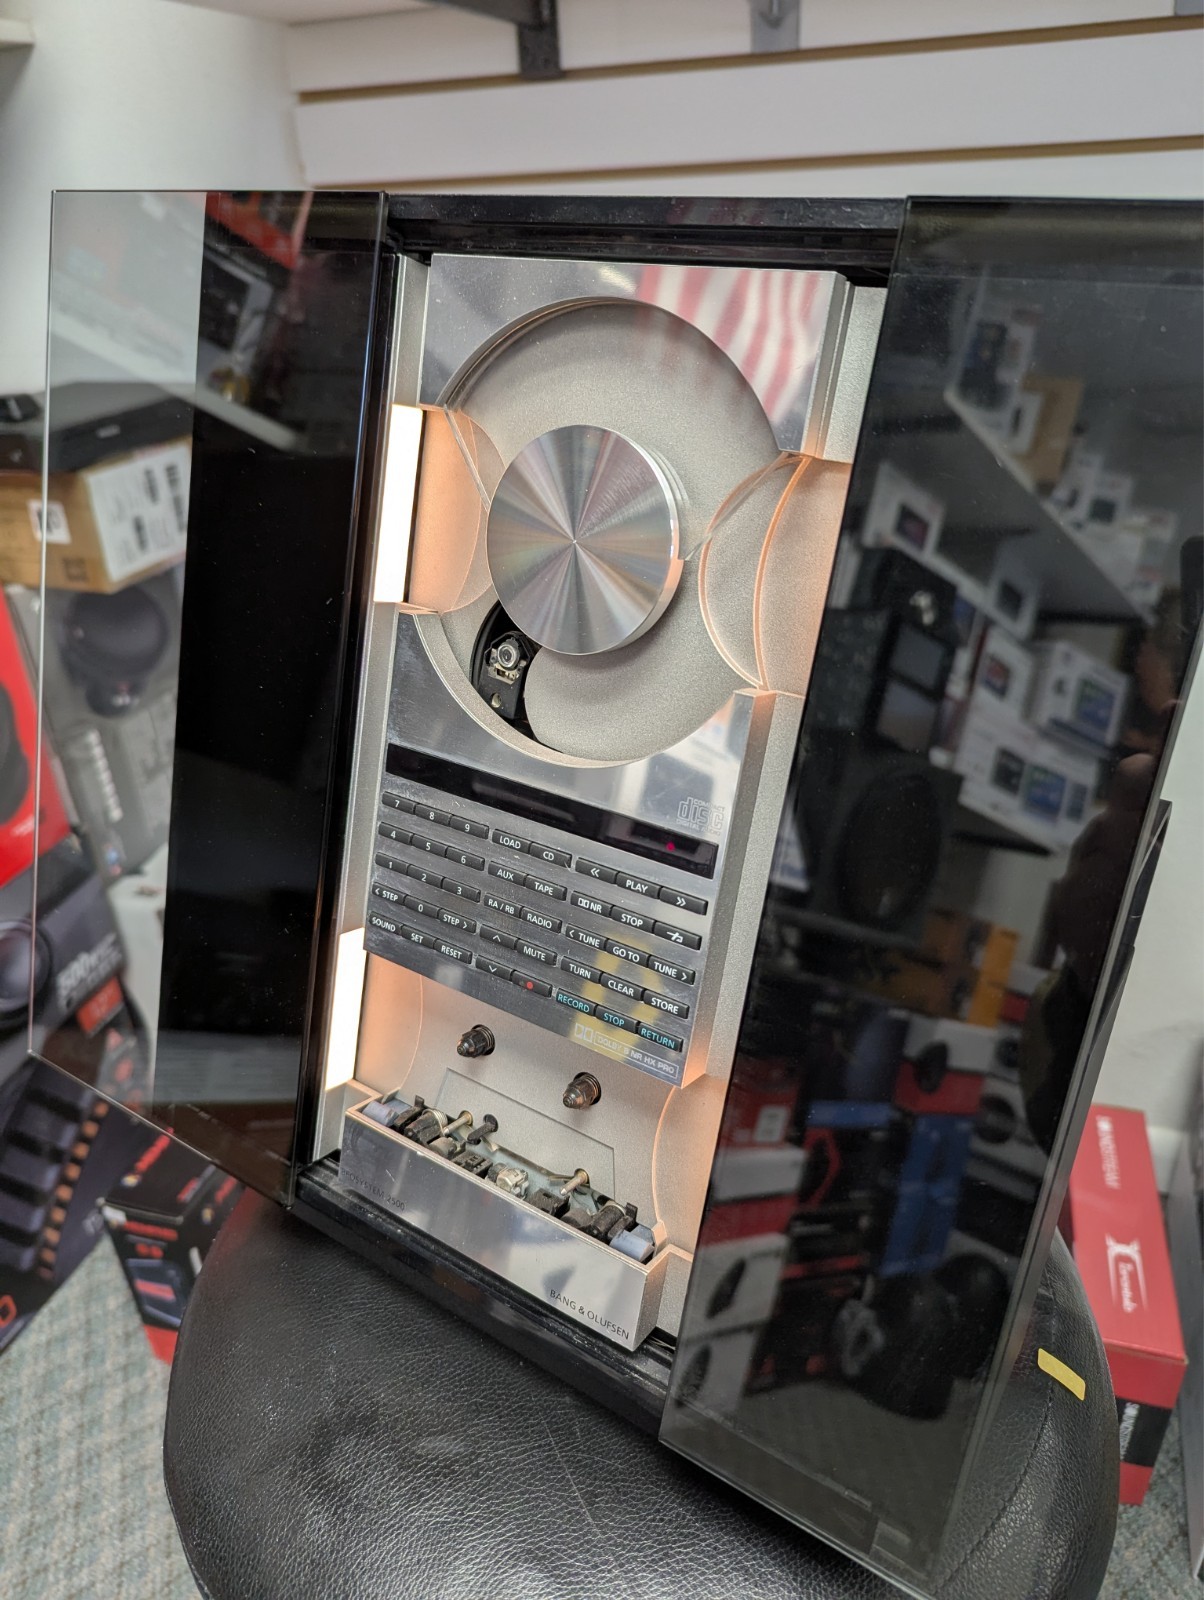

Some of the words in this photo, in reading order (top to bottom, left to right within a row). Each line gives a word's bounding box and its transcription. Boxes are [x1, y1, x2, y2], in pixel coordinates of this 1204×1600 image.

[394, 800, 400, 808] 7
[429, 812, 435, 820] 8
[390, 830, 396, 839] 4
[464, 824, 470, 832] 9
[426, 842, 431, 851] 5
[500, 836, 521, 850] LOAD
[460, 855, 466, 864] 6
[542, 850, 555, 861] CD
[388, 861, 392, 869] 1
[422, 873, 427, 882] 2
[496, 868, 514, 881] AUX
[456, 886, 462, 896] 3
[534, 881, 554, 896] TAPE
[626, 879, 648, 894] PLAY
[382, 890, 399, 902] STEP
[488, 898, 499, 910] RA
[504, 904, 515, 915] RB
[372, 916, 396, 932] SOUND
[442, 913, 460, 926] STEP
[526, 912, 552, 929] RADIO
[621, 913, 644, 928] STOP
[410, 932, 424, 944] SET
[578, 932, 600, 948] TUNE
[440, 944, 462, 960] RESET
[523, 945, 546, 961] MUTE
[612, 946, 627, 958] GO
[627, 950, 640, 962] TO
[568, 962, 592, 979] TURN
[654, 960, 678, 978] TUNE
[607, 979, 634, 998] CLEAR
[557, 992, 590, 1014] RECORD
[651, 996, 680, 1015] STORE
[603, 1012, 625, 1027] STOP
[640, 1027, 675, 1049] RETURN
[598, 1036, 622, 1053] DOLBY
[630, 1050, 642, 1062] NR
[643, 1054, 656, 1067] HX
[657, 1060, 675, 1075] PRO
[386, 1194, 406, 1212] 2500
[549, 1288, 577, 1311] BANG
[578, 1305, 585, 1316] &
[586, 1310, 630, 1340] OLUFSEN
